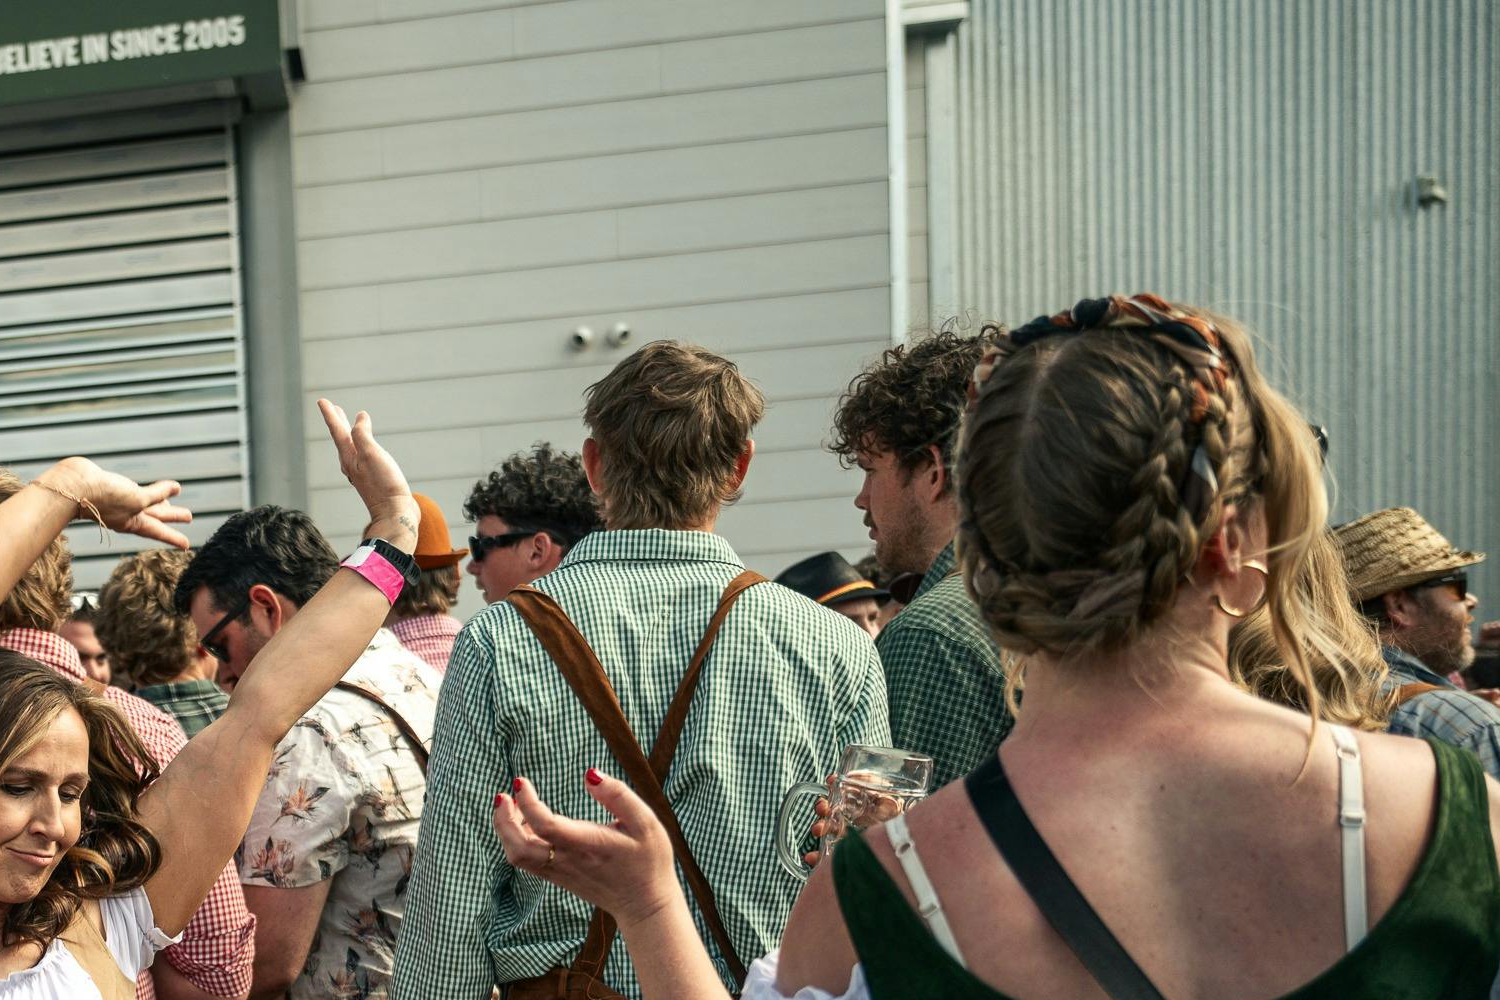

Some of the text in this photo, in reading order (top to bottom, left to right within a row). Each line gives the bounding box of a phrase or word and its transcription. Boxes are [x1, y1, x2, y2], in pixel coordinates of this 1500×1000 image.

[82, 34, 108, 65] IN
[110, 24, 181, 61] SINCE
[183, 16, 246, 52] 2005
